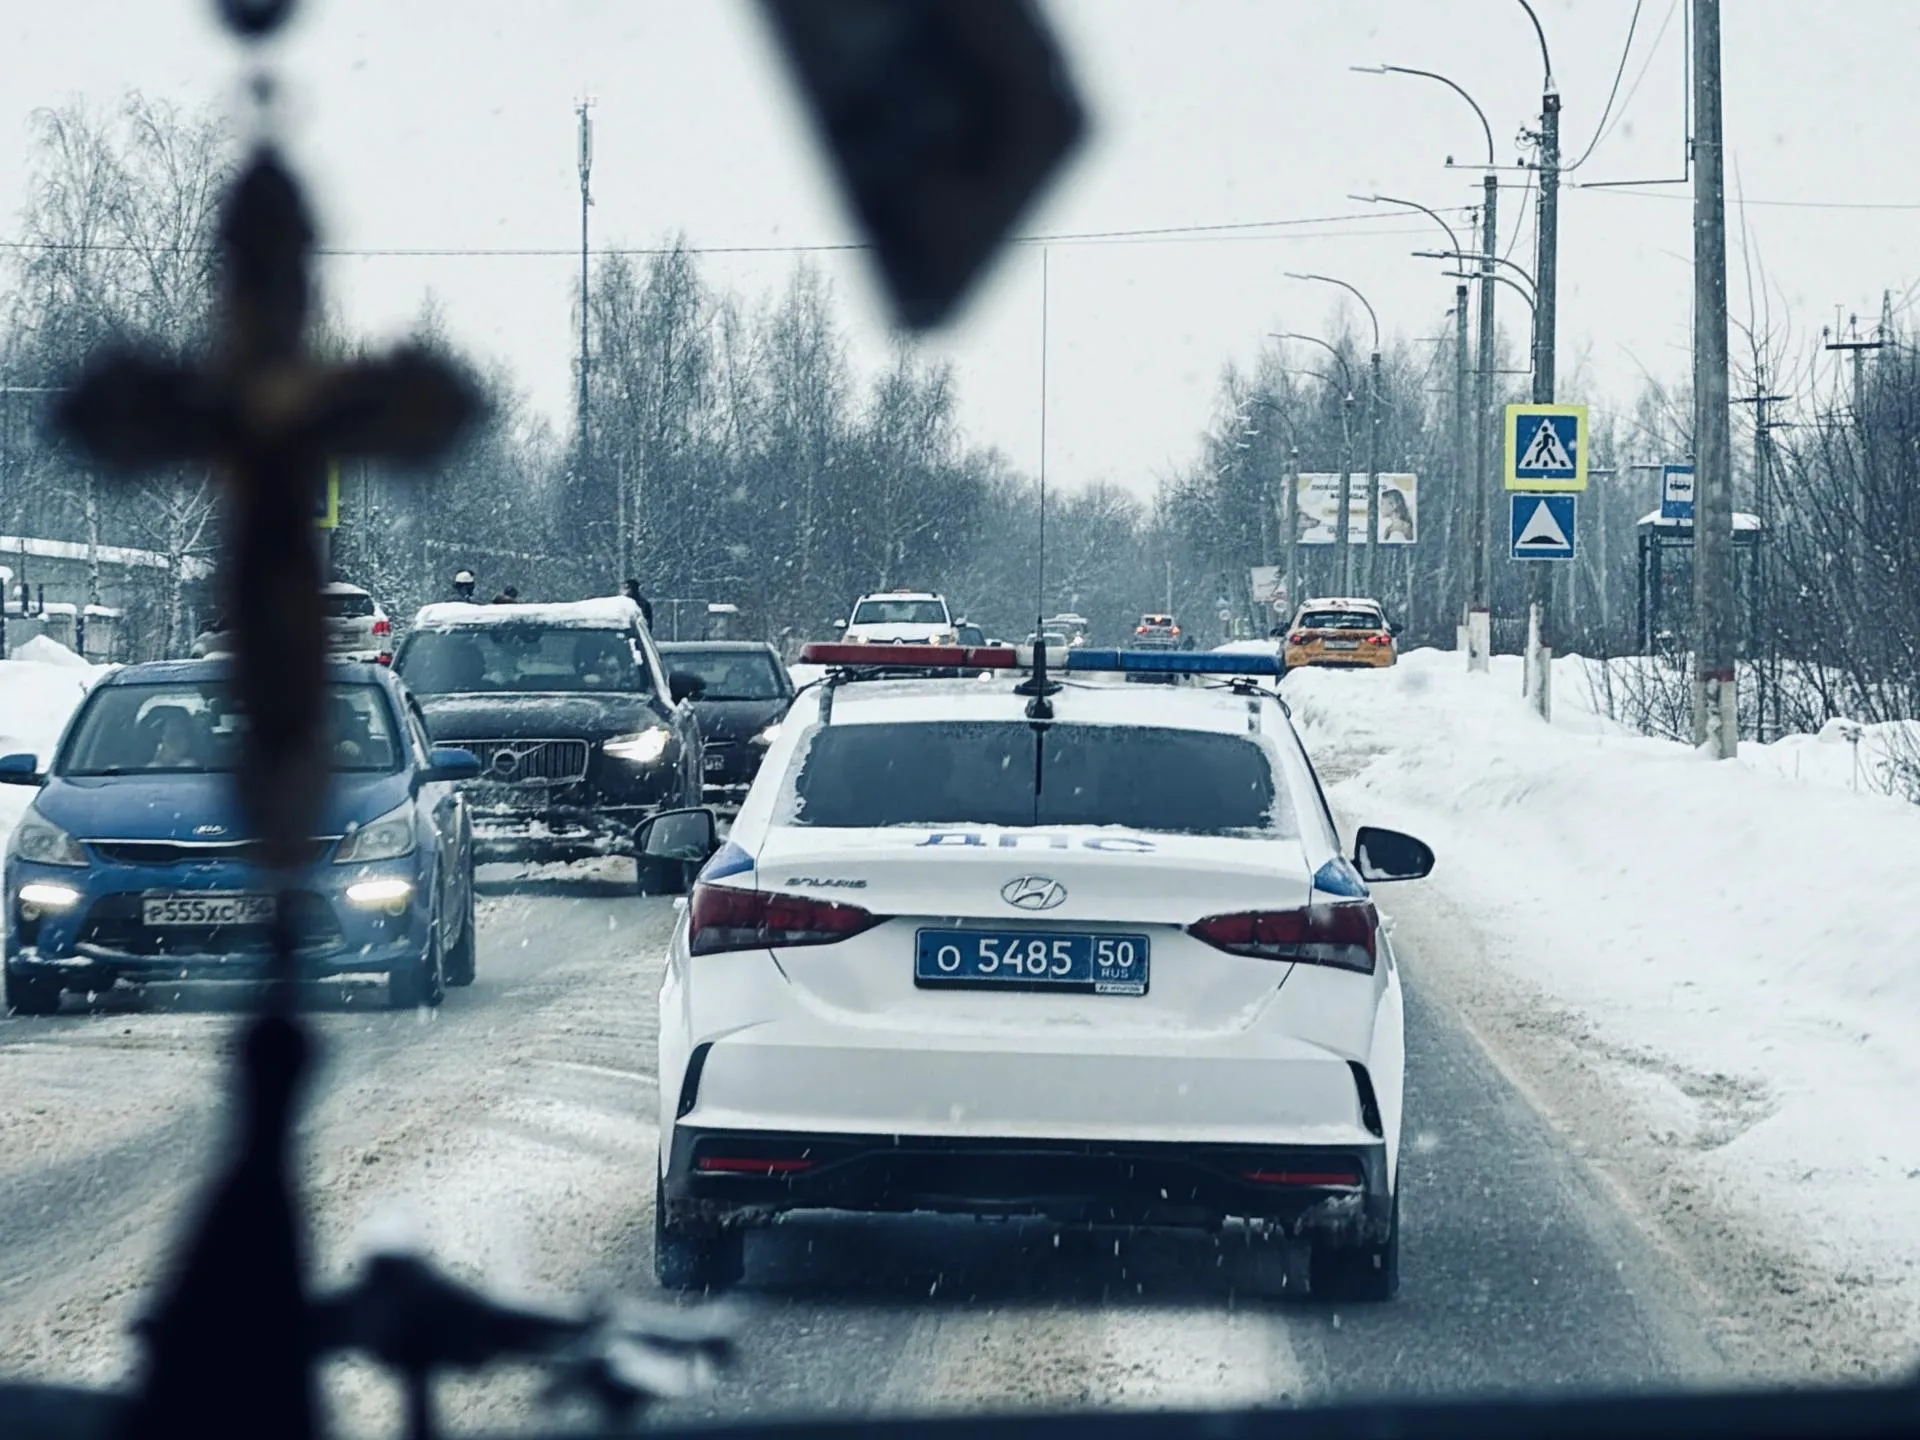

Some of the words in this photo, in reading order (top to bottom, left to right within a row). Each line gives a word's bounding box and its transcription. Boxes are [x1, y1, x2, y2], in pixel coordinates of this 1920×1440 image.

[914, 833, 1156, 853] ДПС
[977, 938, 1073, 975] 5485
[1097, 940, 1134, 968] 50
[1101, 967, 1129, 979] RUS
